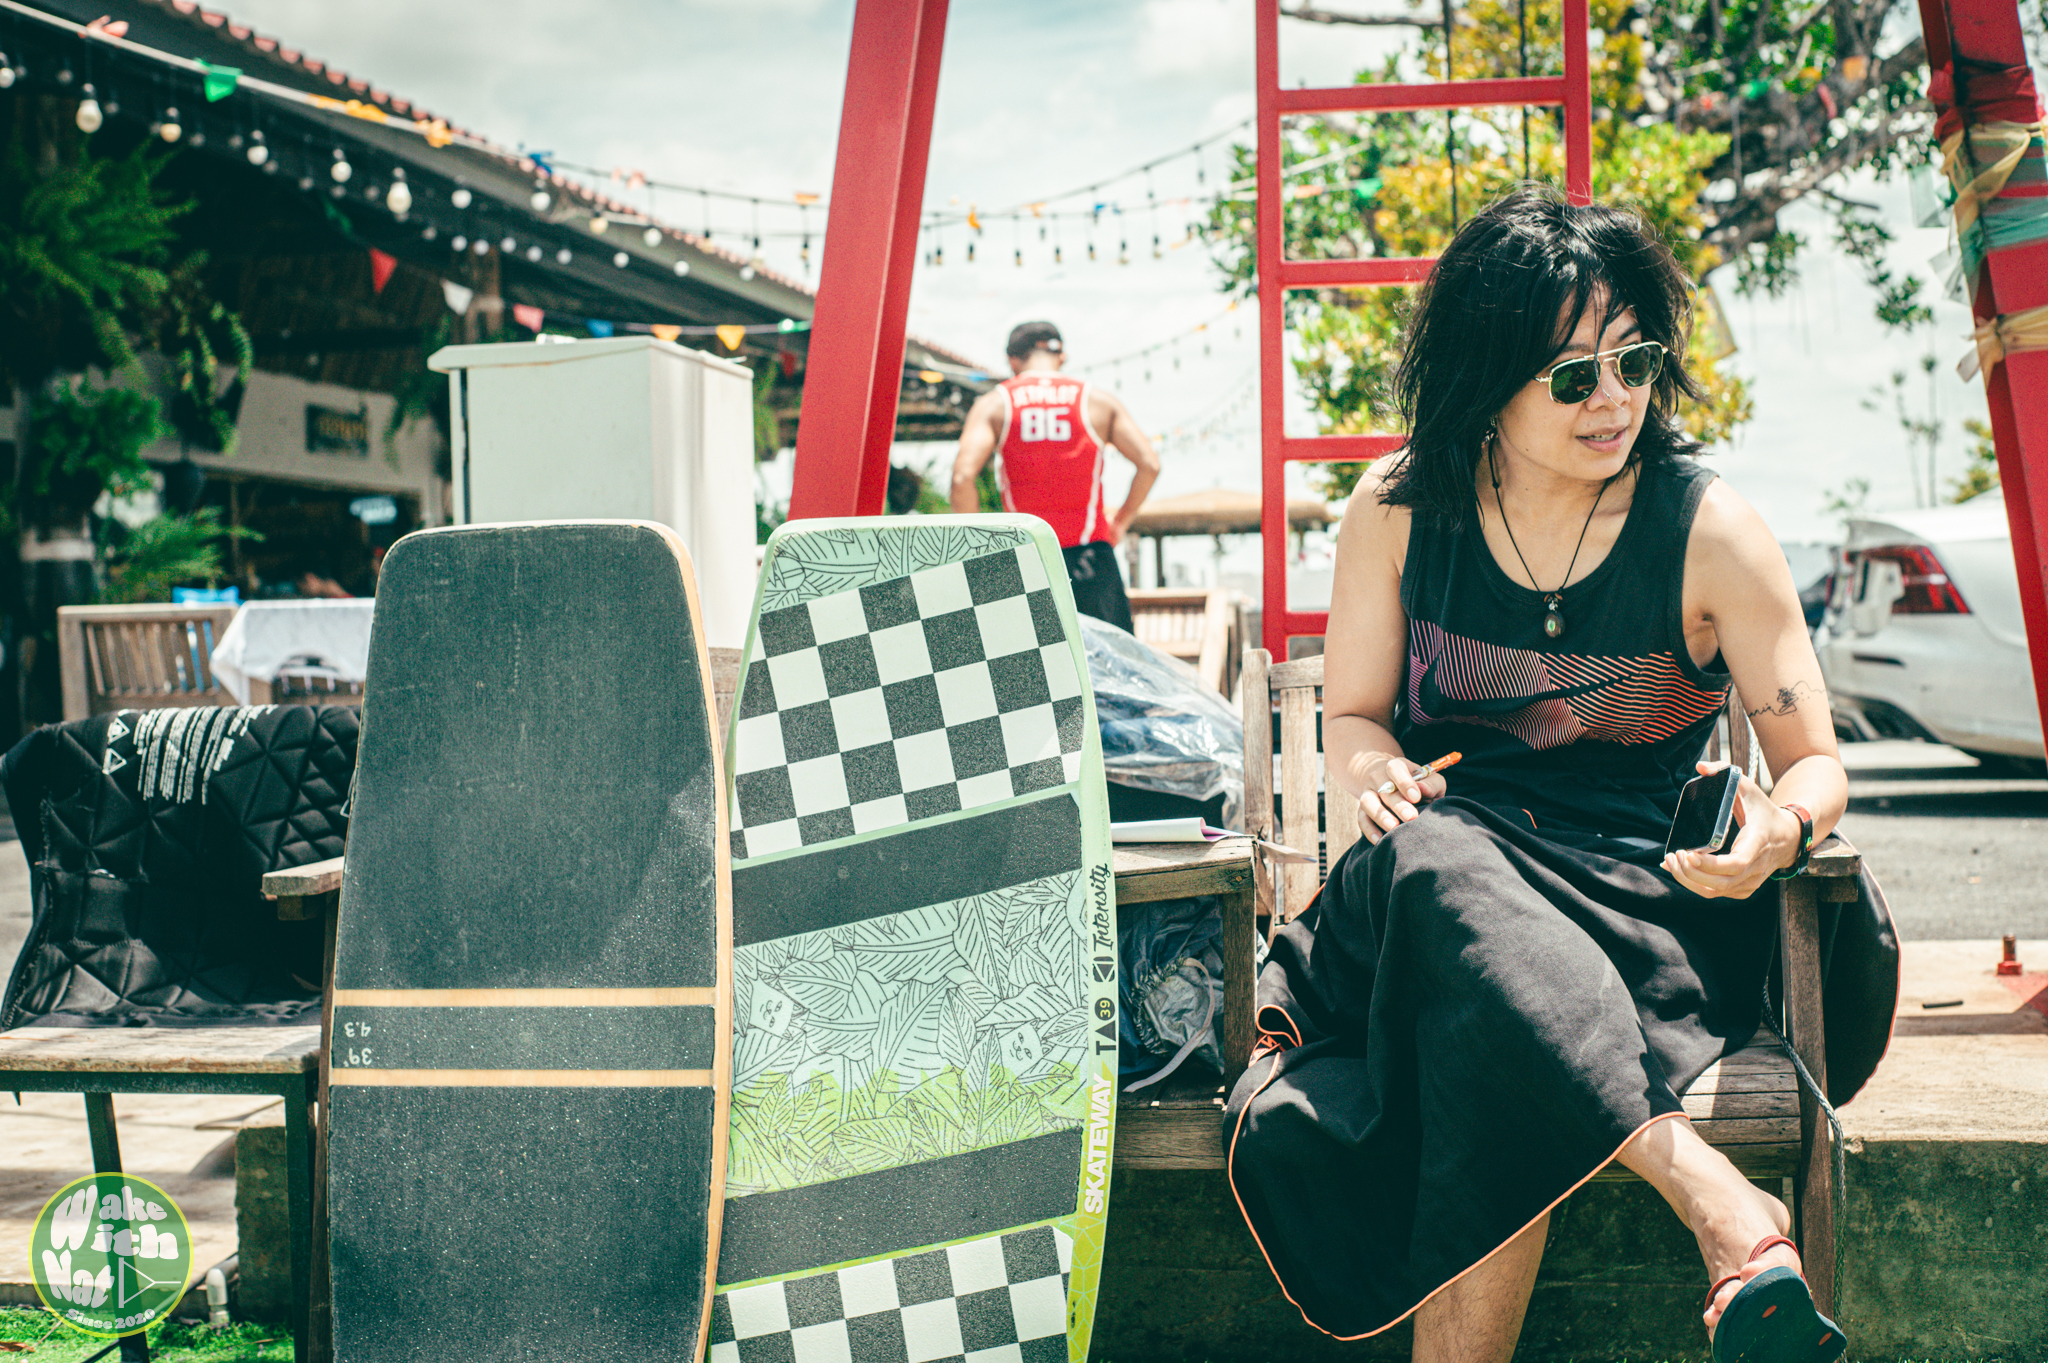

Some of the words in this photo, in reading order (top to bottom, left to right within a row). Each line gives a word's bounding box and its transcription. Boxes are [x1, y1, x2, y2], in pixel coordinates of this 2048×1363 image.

[1020, 407, 1072, 442] 86
[1089, 863, 1114, 952] Intensity
[1084, 1072, 1112, 1214] SKATEWAY
